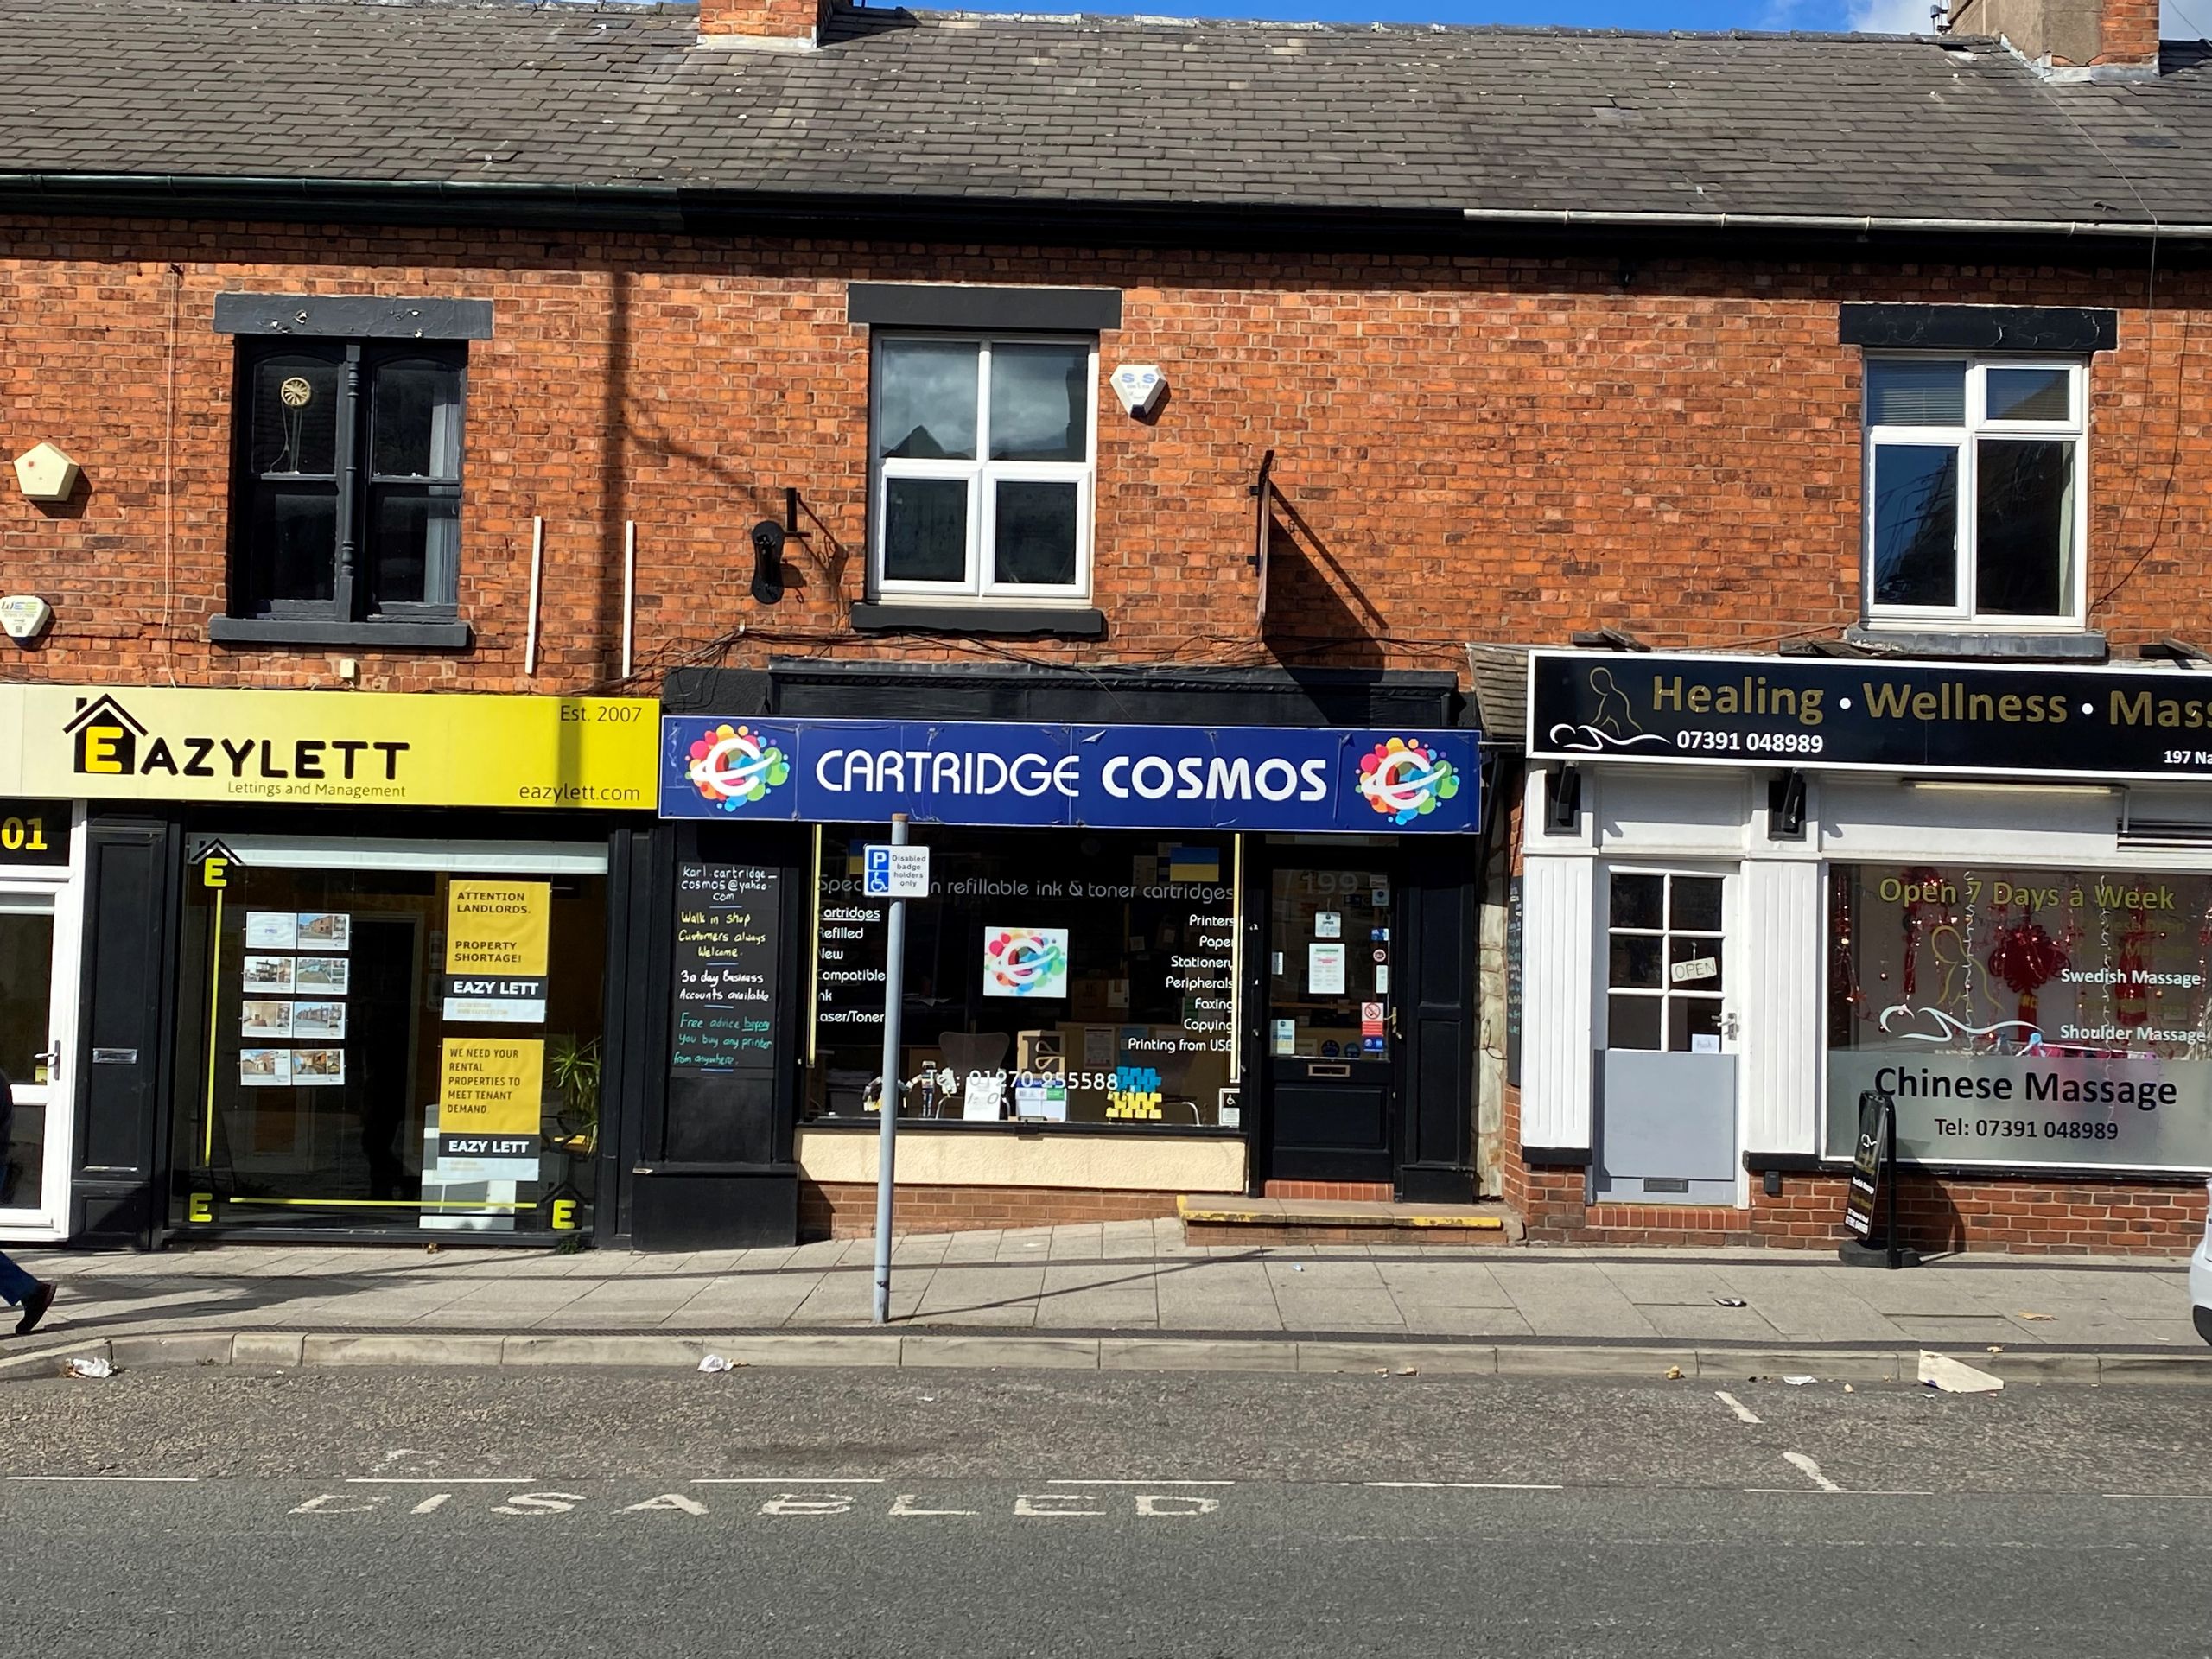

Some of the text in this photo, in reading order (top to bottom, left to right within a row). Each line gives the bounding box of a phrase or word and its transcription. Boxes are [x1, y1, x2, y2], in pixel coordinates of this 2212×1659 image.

[1652, 675, 2212, 728] Healing Wellness Mas
[560, 704, 641, 722] Est. 2007
[1677, 730, 1823, 754] 07391 048989
[2164, 750, 2191, 764] 197
[816, 749, 1328, 802] CARTRIDGE COSMOS
[228, 782, 405, 799] Lettings and Management
[519, 783, 640, 804] eazylett.com
[457, 892, 524, 901] ATTENTION
[712, 892, 734, 901] com
[948, 879, 1029, 896] refillable
[1037, 880, 1062, 897] ink
[1069, 881, 1083, 897] &
[1088, 882, 1137, 899] toner
[1143, 883, 1234, 905] cartridges
[1879, 878, 2175, 910] Open 7 Days a Week
[457, 905, 531, 914] LANDLORDS.
[681, 911, 751, 927] Walk in shop
[1189, 914, 1234, 927] Printers
[678, 929, 766, 945] Customers always
[455, 941, 517, 950] PROPERTY
[454, 953, 522, 963] SHORTAGE!
[681, 969, 696, 983] 30
[700, 969, 719, 987] day
[1675, 963, 1715, 979] OPEN
[2061, 969, 2201, 988] Swedish Massage
[453, 981, 539, 995] EAZY LETT
[1166, 976, 1233, 991] Peripherals
[679, 988, 723, 1000] Accounts
[817, 989, 832, 1001] nk
[680, 1012, 703, 1028] Free
[709, 1017, 740, 1028] advice
[817, 1010, 885, 1022] aser/Toner
[1184, 1018, 1232, 1033] Copying
[702, 1034, 718, 1048] buy
[723, 1038, 739, 1049] any
[741, 1037, 772, 1050] printer
[2060, 1025, 2206, 1044] Shoulder Massage
[449, 1048, 518, 1058] WE NEED YOUR
[1128, 1038, 1176, 1054] Printing
[1179, 1039, 1206, 1051] from
[674, 1051, 691, 1064] from
[449, 1062, 484, 1072] RENTAL
[448, 1076, 520, 1086] PROPERTIES TO
[1041, 1071, 1119, 1090] 255588
[448, 1090, 512, 1100] MEET TENANT
[1875, 1068, 2177, 1110] Chinese Massage
[1935, 1118, 2118, 1140] Tel: 07391 048989
[448, 1140, 529, 1154] EAZY LETT
